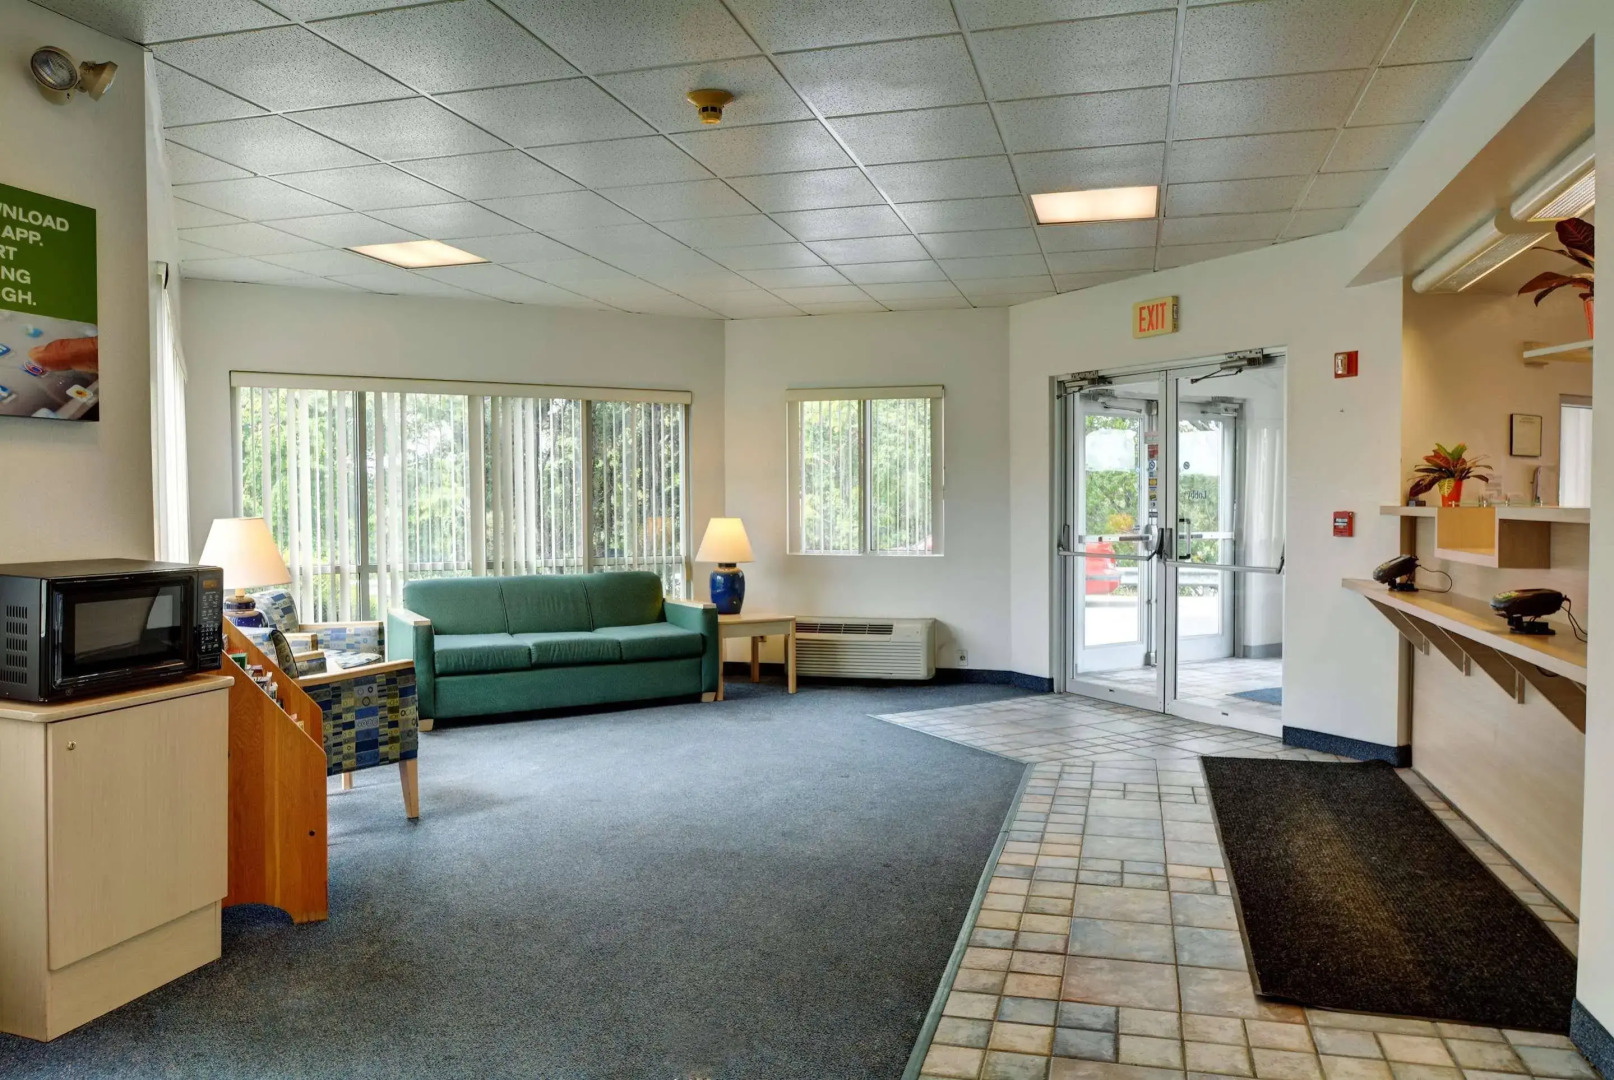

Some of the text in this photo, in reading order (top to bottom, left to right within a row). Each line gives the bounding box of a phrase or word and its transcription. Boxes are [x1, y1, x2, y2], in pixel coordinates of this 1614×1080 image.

[0, 203, 70, 232] NLOAD
[1, 225, 44, 247] APP.
[1, 265, 31, 285] NG
[1, 287, 37, 306] GH.
[1139, 302, 1167, 333] EXIT
